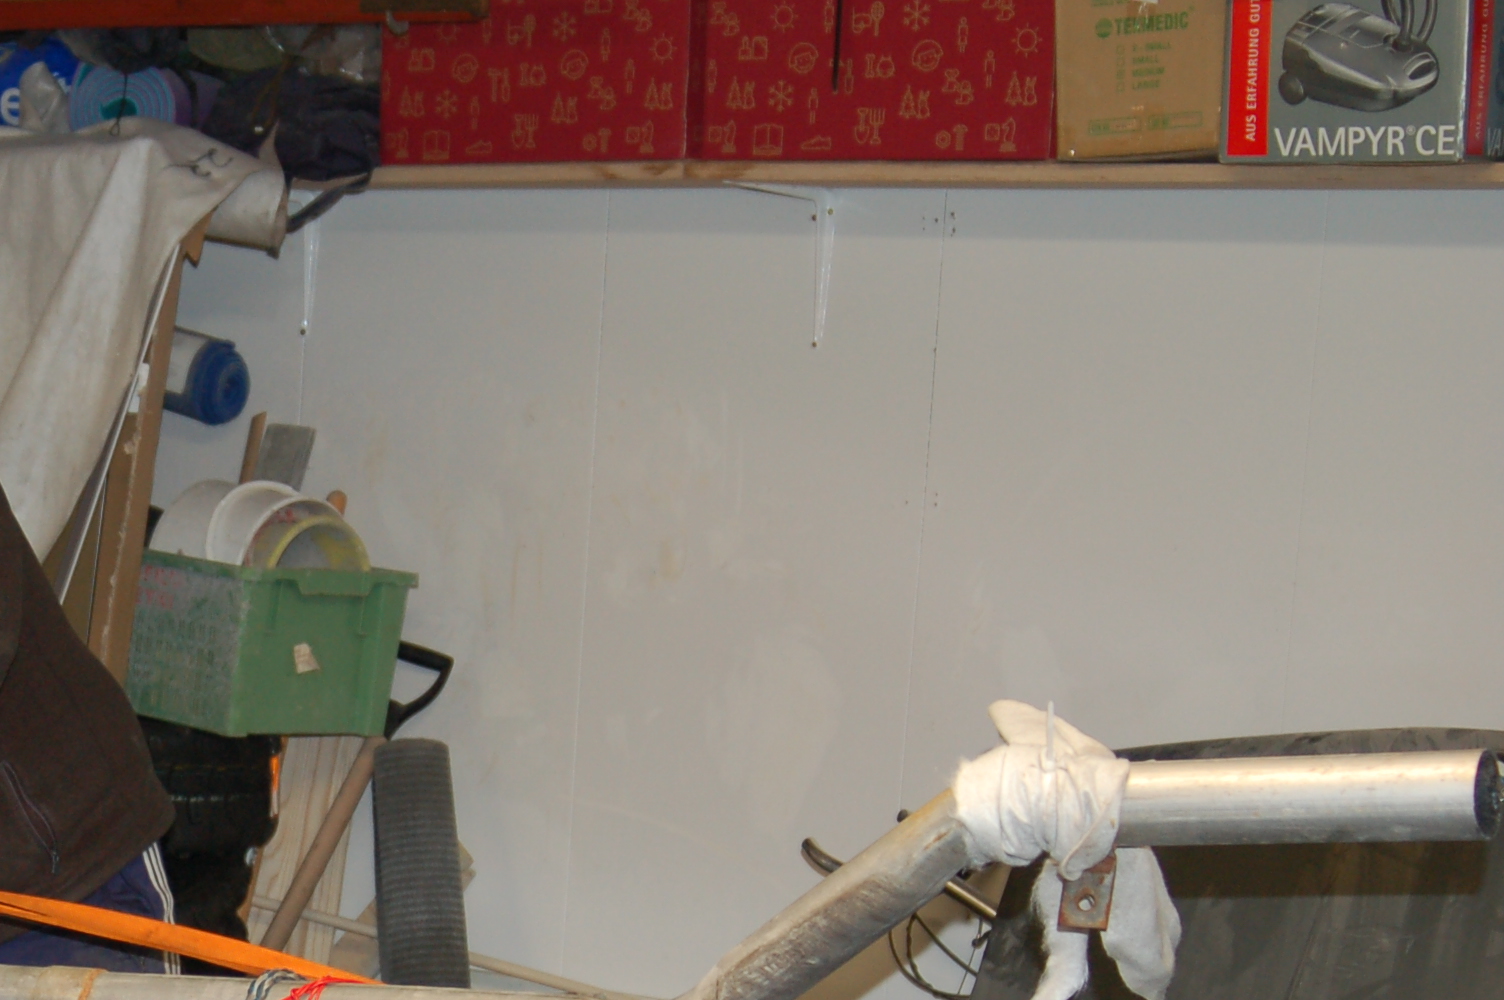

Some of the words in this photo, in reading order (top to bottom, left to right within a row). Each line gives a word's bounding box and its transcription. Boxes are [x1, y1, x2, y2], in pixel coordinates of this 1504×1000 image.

[1246, 27, 1260, 110] ERFAHRUNG
[1245, 113, 1257, 142] AUS
[1415, 125, 1456, 156] CE
